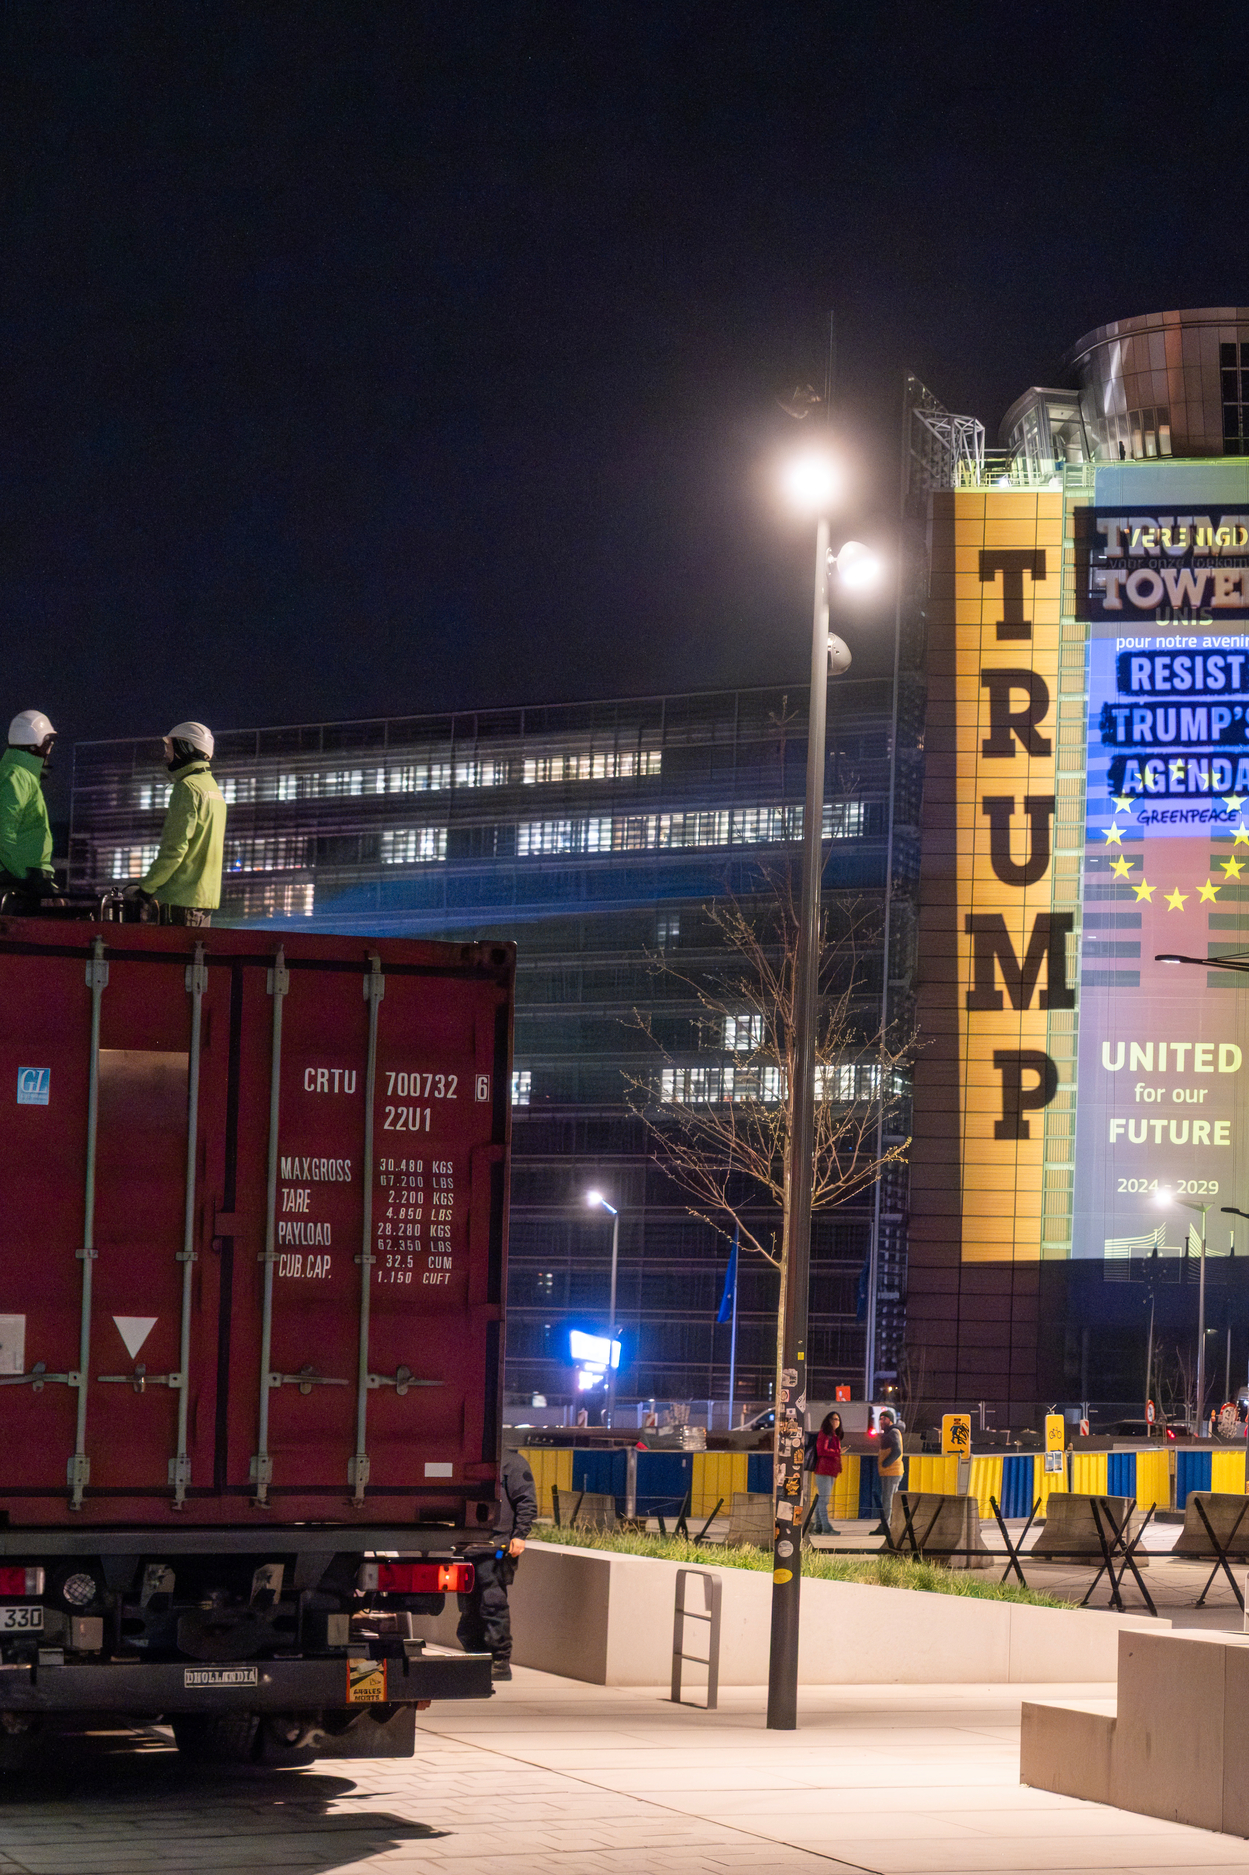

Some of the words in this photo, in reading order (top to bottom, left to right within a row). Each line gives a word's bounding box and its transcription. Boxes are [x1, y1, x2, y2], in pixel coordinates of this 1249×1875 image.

[1155, 607, 1214, 626] UNIS
[1116, 637, 1151, 651] pour
[1156, 635, 1197, 648] notre
[1131, 655, 1245, 690] RESIST
[1137, 808, 1238, 826] GREENPEACE
[965, 549, 1074, 1140] TRUMP
[1101, 1041, 1242, 1073] UNITED
[20, 1069, 48, 1093] GL
[304, 1068, 356, 1094] CRTU
[385, 1072, 458, 1099] 700732
[477, 1076, 488, 1100] 6
[1134, 1083, 1166, 1103] for
[1173, 1088, 1208, 1103] our
[383, 1106, 431, 1131] 22U1
[1109, 1118, 1231, 1146] FUTURE
[380, 1159, 423, 1173] 30.480
[432, 1161, 453, 1174] KGS
[380, 1175, 424, 1187] 67.200
[432, 1177, 454, 1189] LBS
[1117, 1178, 1159, 1193] 2024
[1177, 1180, 1219, 1195] 2029
[282, 1188, 311, 1212] TARE
[388, 1190, 424, 1204] 2.200
[433, 1192, 454, 1205] KGS
[386, 1207, 422, 1220] 4.850
[430, 1209, 453, 1221] LBS
[278, 1221, 331, 1246] PAYLOAD
[377, 1222, 421, 1236] 28.280
[430, 1224, 451, 1237] KGS
[378, 1239, 421, 1251] 62.350
[430, 1240, 452, 1253] LBS
[278, 1254, 332, 1279] CUB.CAP.
[386, 1255, 413, 1268] 32.5
[428, 1255, 452, 1269] CUM
[377, 1271, 412, 1284] 1.150
[422, 1272, 451, 1285] CUFT
[4, 1608, 42, 1628] 330
[185, 1671, 256, 1684] DHOLLANDIA
[353, 1687, 382, 1695] ANGLES
